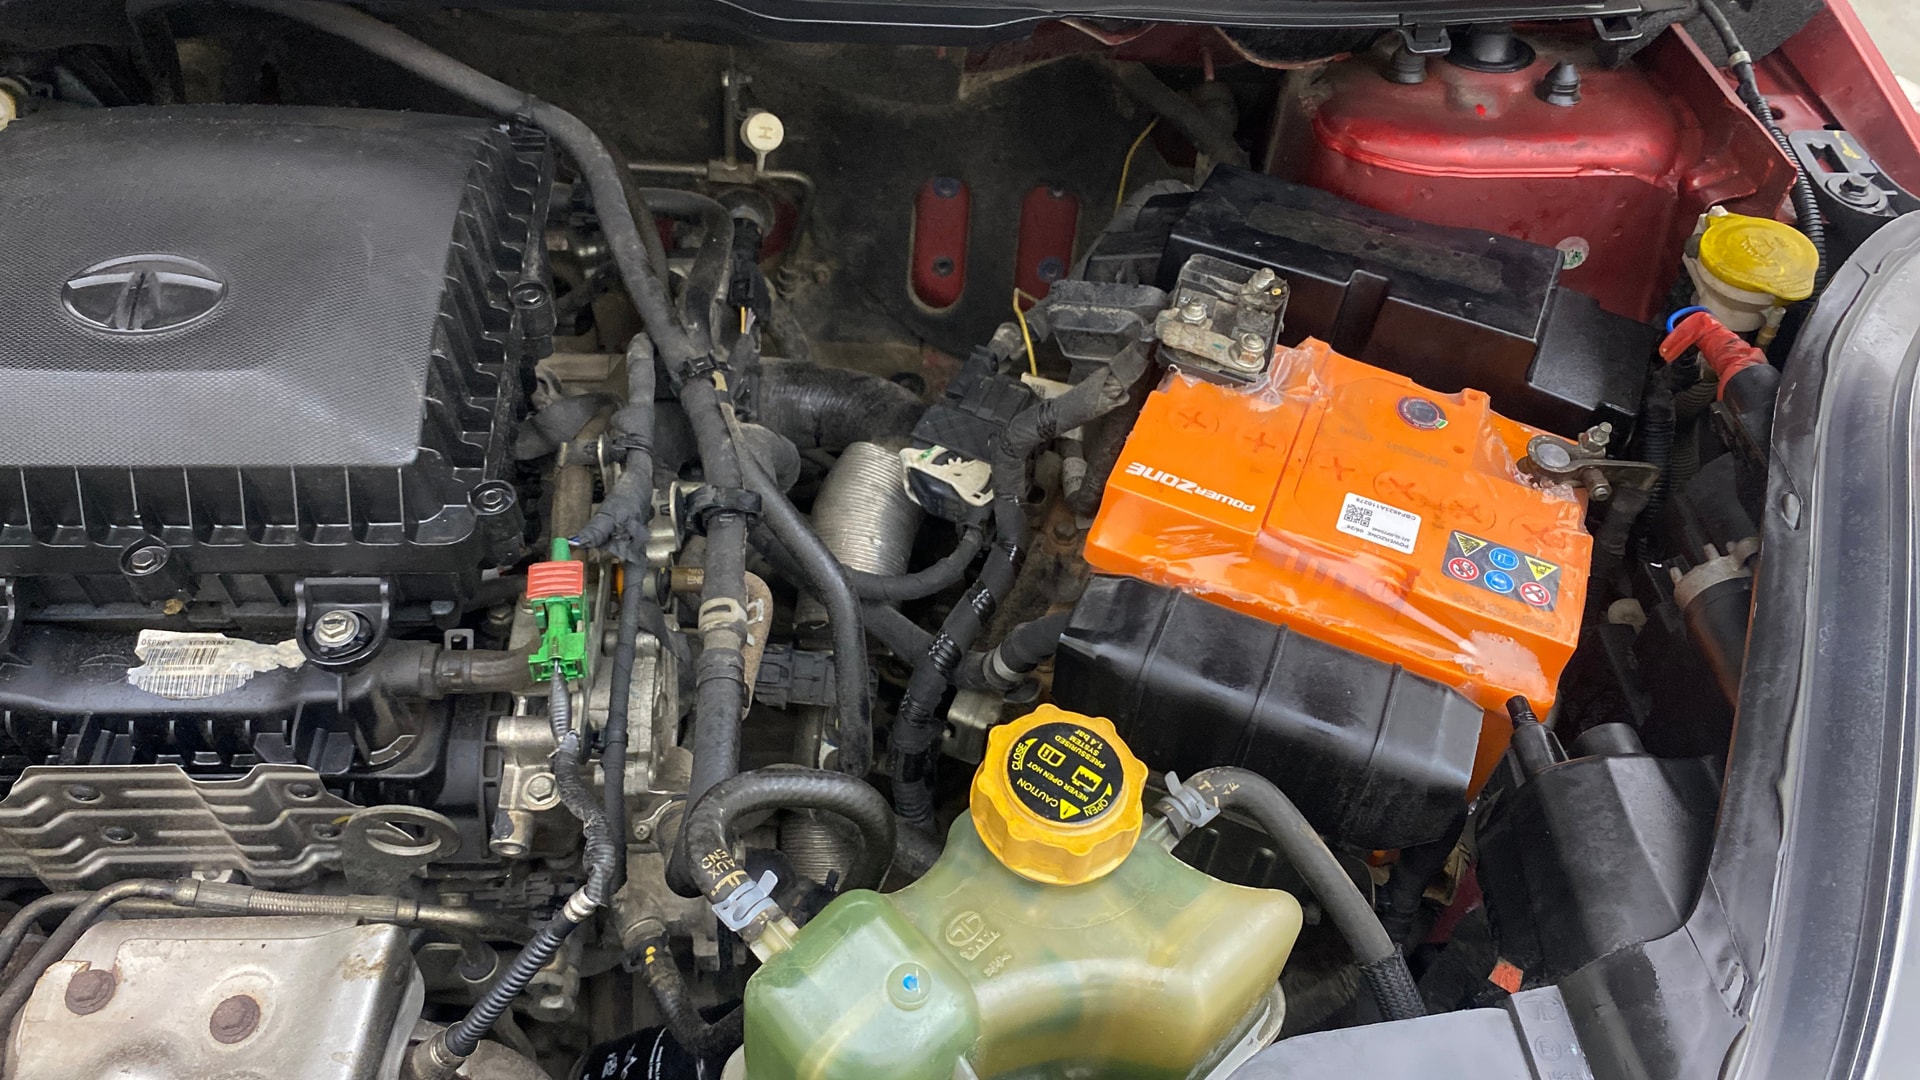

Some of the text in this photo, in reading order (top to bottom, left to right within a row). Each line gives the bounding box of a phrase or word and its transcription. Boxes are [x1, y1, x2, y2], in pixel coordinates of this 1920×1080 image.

[1367, 531, 1409, 549] POWERZONE
[1068, 735, 1100, 757] SYSTEM
[1074, 729, 1103, 750] 1.4 bar
[1011, 742, 1027, 771] CLOSE
[1054, 734, 1106, 769] PRESSURISED
[1017, 777, 1059, 808] CAUTION
[1026, 761, 1089, 802] NEVER OPEN HOT
[1083, 798, 1109, 817] OPEN
[706, 858, 736, 881] AUX
